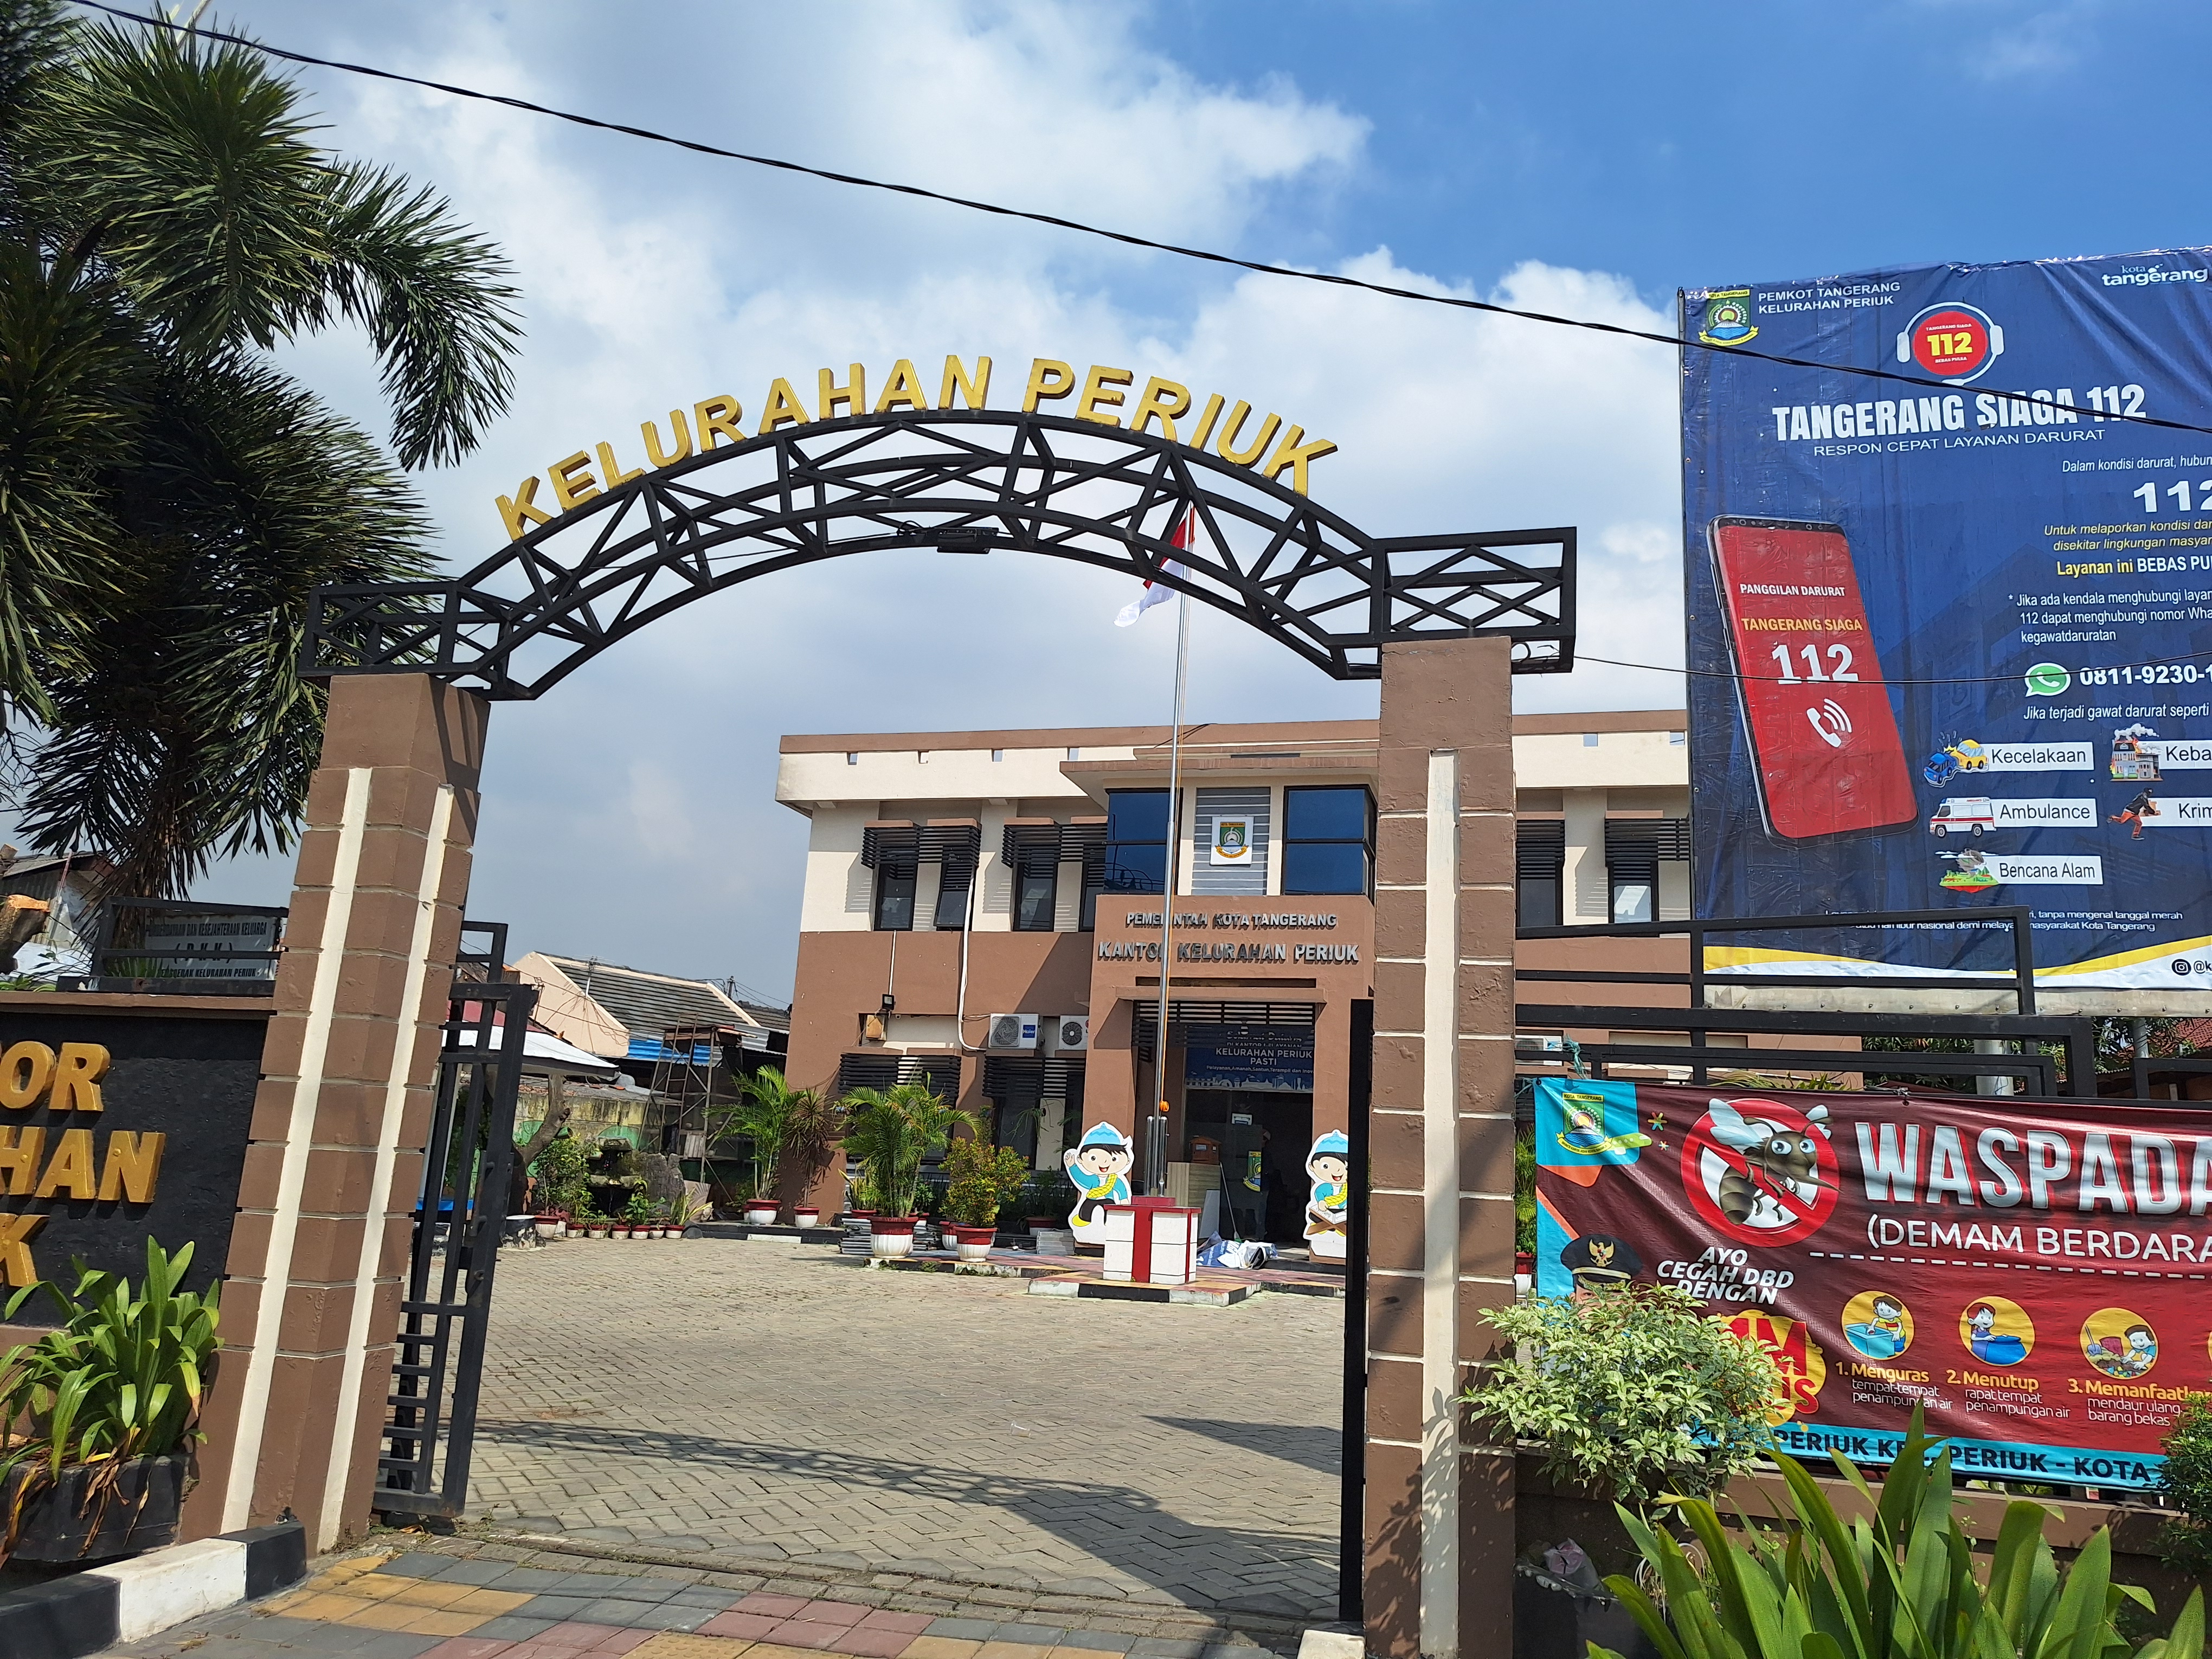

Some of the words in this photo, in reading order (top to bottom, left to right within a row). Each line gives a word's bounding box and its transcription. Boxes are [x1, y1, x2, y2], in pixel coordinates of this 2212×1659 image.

[2101, 268, 2208, 286] tangerang
[2121, 265, 2146, 274] kota
[1758, 288, 1812, 302] PEMKOT
[1816, 281, 1901, 298] TANGERANG
[1758, 300, 1841, 314] KELURAHAN
[1843, 295, 1894, 308] PERIUK
[1927, 332, 1973, 356] 112
[1772, 394, 1965, 441] TANGERANG
[1975, 388, 2079, 431] SIAGA
[2087, 384, 2147, 422] 112
[494, 355, 992, 542] KELURAHAN
[1021, 358, 1338, 497] PERIUK
[1814, 442, 1882, 456] RESPON
[1887, 439, 1940, 452] CEPAT
[1944, 433, 2020, 449] LAYANAN
[2024, 429, 2106, 444] DARURAT
[2062, 460, 2095, 473] Dalam
[2098, 458, 2134, 471] kondisi
[2137, 455, 2177, 470] darurat,
[2044, 524, 2078, 536] Untuk
[2080, 522, 2146, 536] melaporkan
[2150, 519, 2191, 532] kondisi
[2053, 539, 2101, 552] disekitar
[2104, 537, 2165, 552] lingkungan
[2056, 560, 2113, 578] Layanan
[2117, 558, 2133, 573] ini
[2137, 556, 2187, 573] BEBAS
[2190, 555, 2212, 570] PU
[1739, 583, 1799, 595] PANGGILAN
[1801, 586, 1846, 596] DARURAT
[2016, 594, 2038, 607] Jika
[2040, 593, 2061, 606] ada
[2063, 591, 2105, 605] kendala
[2108, 588, 2182, 606] menghubungi
[1741, 618, 1823, 631] TANGERANG
[1824, 619, 1863, 631] SIAGA
[2020, 612, 2039, 625] 112
[2041, 611, 2072, 627] dapat
[2074, 608, 2147, 626] menghubungi
[2150, 609, 2185, 621] nomor
[2021, 629, 2117, 646] kegawatdaruratan
[1771, 644, 1859, 685] 112
[2023, 705, 2046, 720] Jika
[2048, 704, 2085, 722] terjadi
[2087, 704, 2122, 721] gawat
[2125, 703, 2167, 718] darurat
[2170, 702, 2209, 720] seperti
[1991, 747, 2086, 764] Kecelakaan
[1999, 802, 2091, 820] Ambulance
[1999, 862, 2060, 878] Bencana
[2062, 862, 2095, 879] Alam
[1127, 912, 1208, 926] PEMENTAH
[1214, 913, 1250, 926] KOTA
[1251, 913, 1338, 927] TANGERANG
[2038, 911, 2065, 919] tanpa
[2067, 910, 2113, 920] mengenal
[2115, 910, 2150, 921] tanggal
[2151, 911, 2183, 919] merah
[1917, 921, 1954, 930] nasional
[1956, 921, 1980, 929] demi
[2082, 921, 2104, 930] Kota
[2105, 922, 2156, 932] Tangerang
[1177, 943, 1287, 961] KELURAHAN
[1295, 944, 1359, 962] PERIUK
[1216, 1047, 1275, 1058] KELURAHAN
[1277, 1050, 1313, 1058] PERIUK
[1250, 1057, 1277, 1066] PASTI
[1867, 1213, 2024, 1253] (DEMAM
[1697, 1246, 1748, 1266] AYO
[1657, 1260, 1740, 1283] CEGAH
[1742, 1268, 1795, 1289] DBD
[1677, 1279, 1778, 1305] DENGAN
[1835, 1361, 1849, 1376] 1.
[1851, 1362, 1930, 1384] Menguras
[1946, 1369, 1961, 1385] 2.
[1963, 1371, 2040, 1393] Menutup
[1852, 1378, 1940, 1397] tempat-tempat
[2067, 1378, 2084, 1394] 3.
[1939, 1398, 1953, 1410] air
[1965, 1388, 1997, 1401] rapat
[1997, 1390, 2043, 1404] tempat
[2088, 1397, 2145, 1411] mendaur
[1965, 1400, 2054, 1418] penampungan
[2055, 1405, 2071, 1418] air
[2088, 1407, 2132, 1426] barang
[2134, 1411, 2171, 1426] bekas
[2075, 1458, 2151, 1481] KOTA
